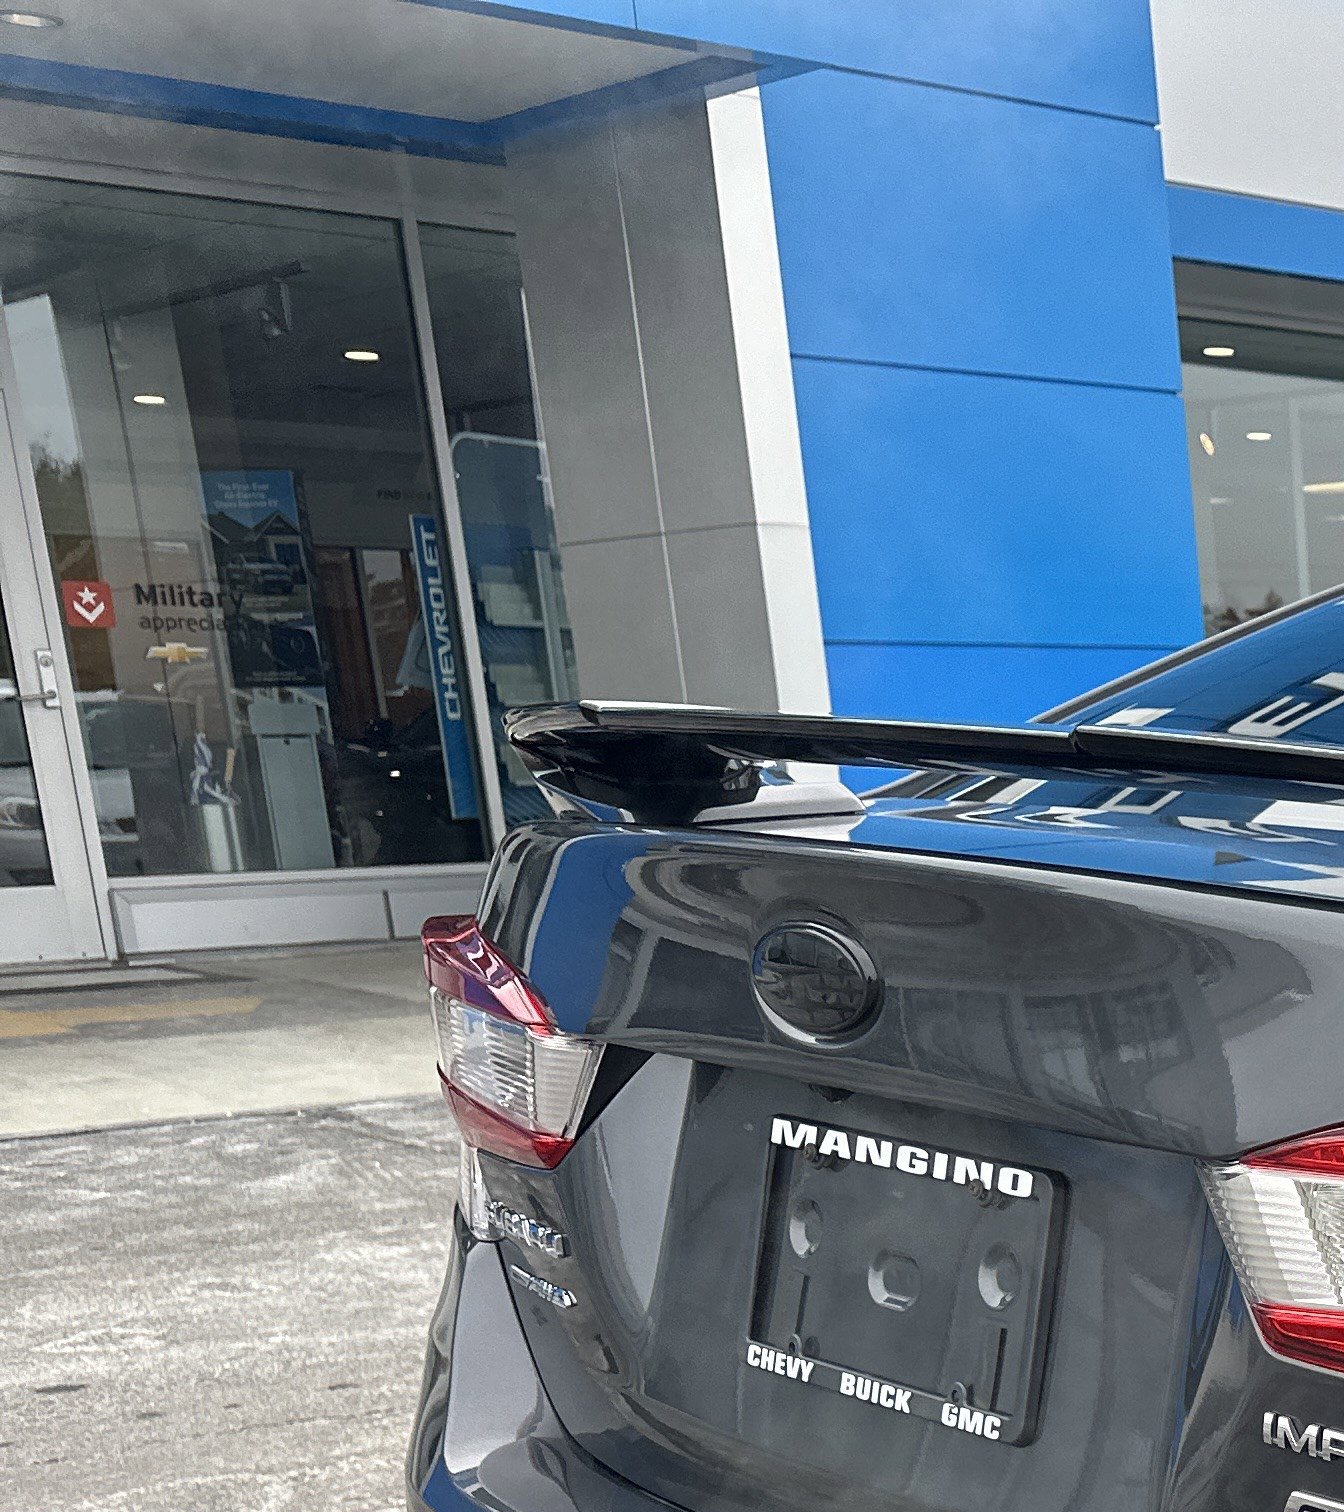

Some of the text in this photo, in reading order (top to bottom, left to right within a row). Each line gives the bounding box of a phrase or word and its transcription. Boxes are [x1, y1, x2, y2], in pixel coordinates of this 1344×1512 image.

[134, 582, 244, 618] Military
[420, 524, 461, 722] CHEVROLET
[770, 1117, 1034, 1198] MANGINO
[746, 1344, 1001, 1440] CHEVY BUICK GMC
